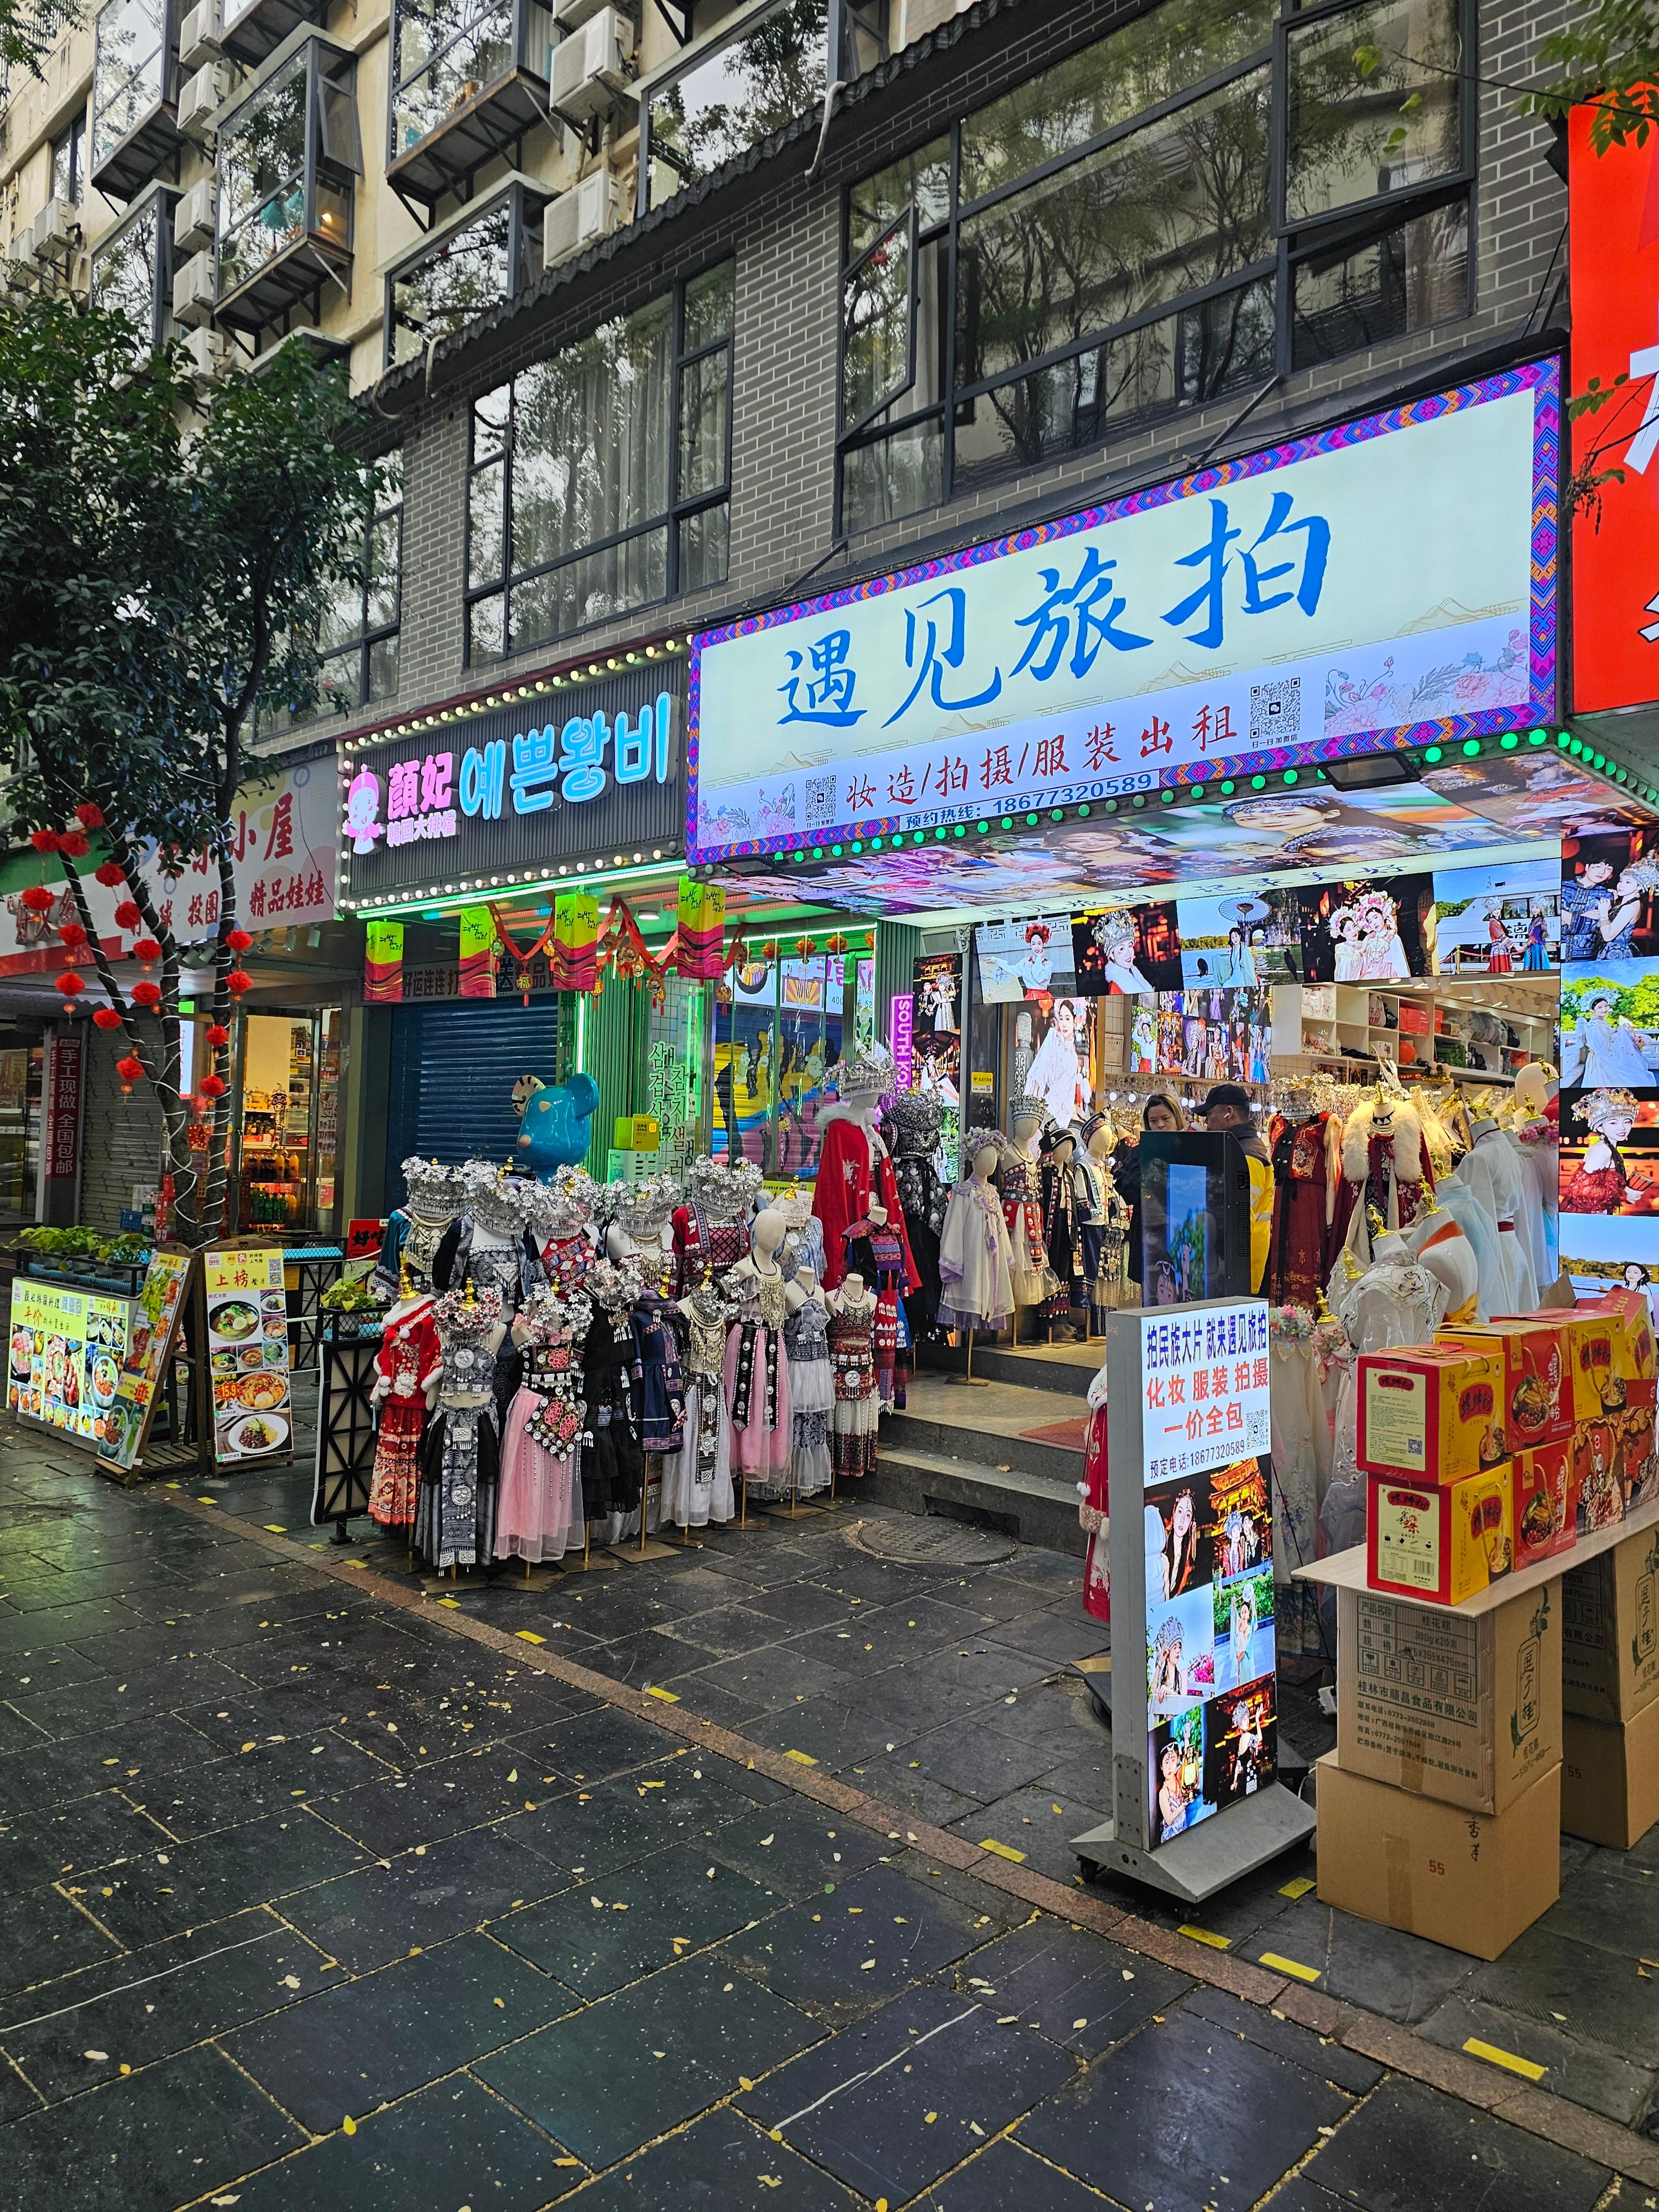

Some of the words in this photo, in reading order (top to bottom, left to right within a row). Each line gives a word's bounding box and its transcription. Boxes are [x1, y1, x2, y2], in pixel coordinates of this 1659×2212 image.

[776, 492, 1331, 729] 遇见旅拍
[459, 691, 671, 820] 예쁜왕비
[993, 773, 1152, 815] 18677320589
[249, 869, 325, 918] 精品娃娃
[897, 1000, 911, 1057] SOUTH
[59, 1049, 78, 1109] 手工现做
[55, 1113, 76, 1174] 全国包邮
[215, 1269, 249, 1288] 上榜
[1147, 1319, 1203, 1370] 拍民族大片
[1206, 1309, 1266, 1360] 就来遇见旅拍
[221, 1384, 236, 1398] 15.9
[1146, 1374, 1186, 1410] 化妆
[1192, 1365, 1229, 1402] 服装
[1234, 1357, 1269, 1393] 拍摄
[1164, 1402, 1243, 1441] 一价全包
[1361, 1602, 1392, 1618] 产品名称
[1358, 1679, 1478, 1724] 桂林市顺昌食品有限公司
[1567, 1765, 1582, 1780] 55
[1428, 1859, 1445, 1876] 55
